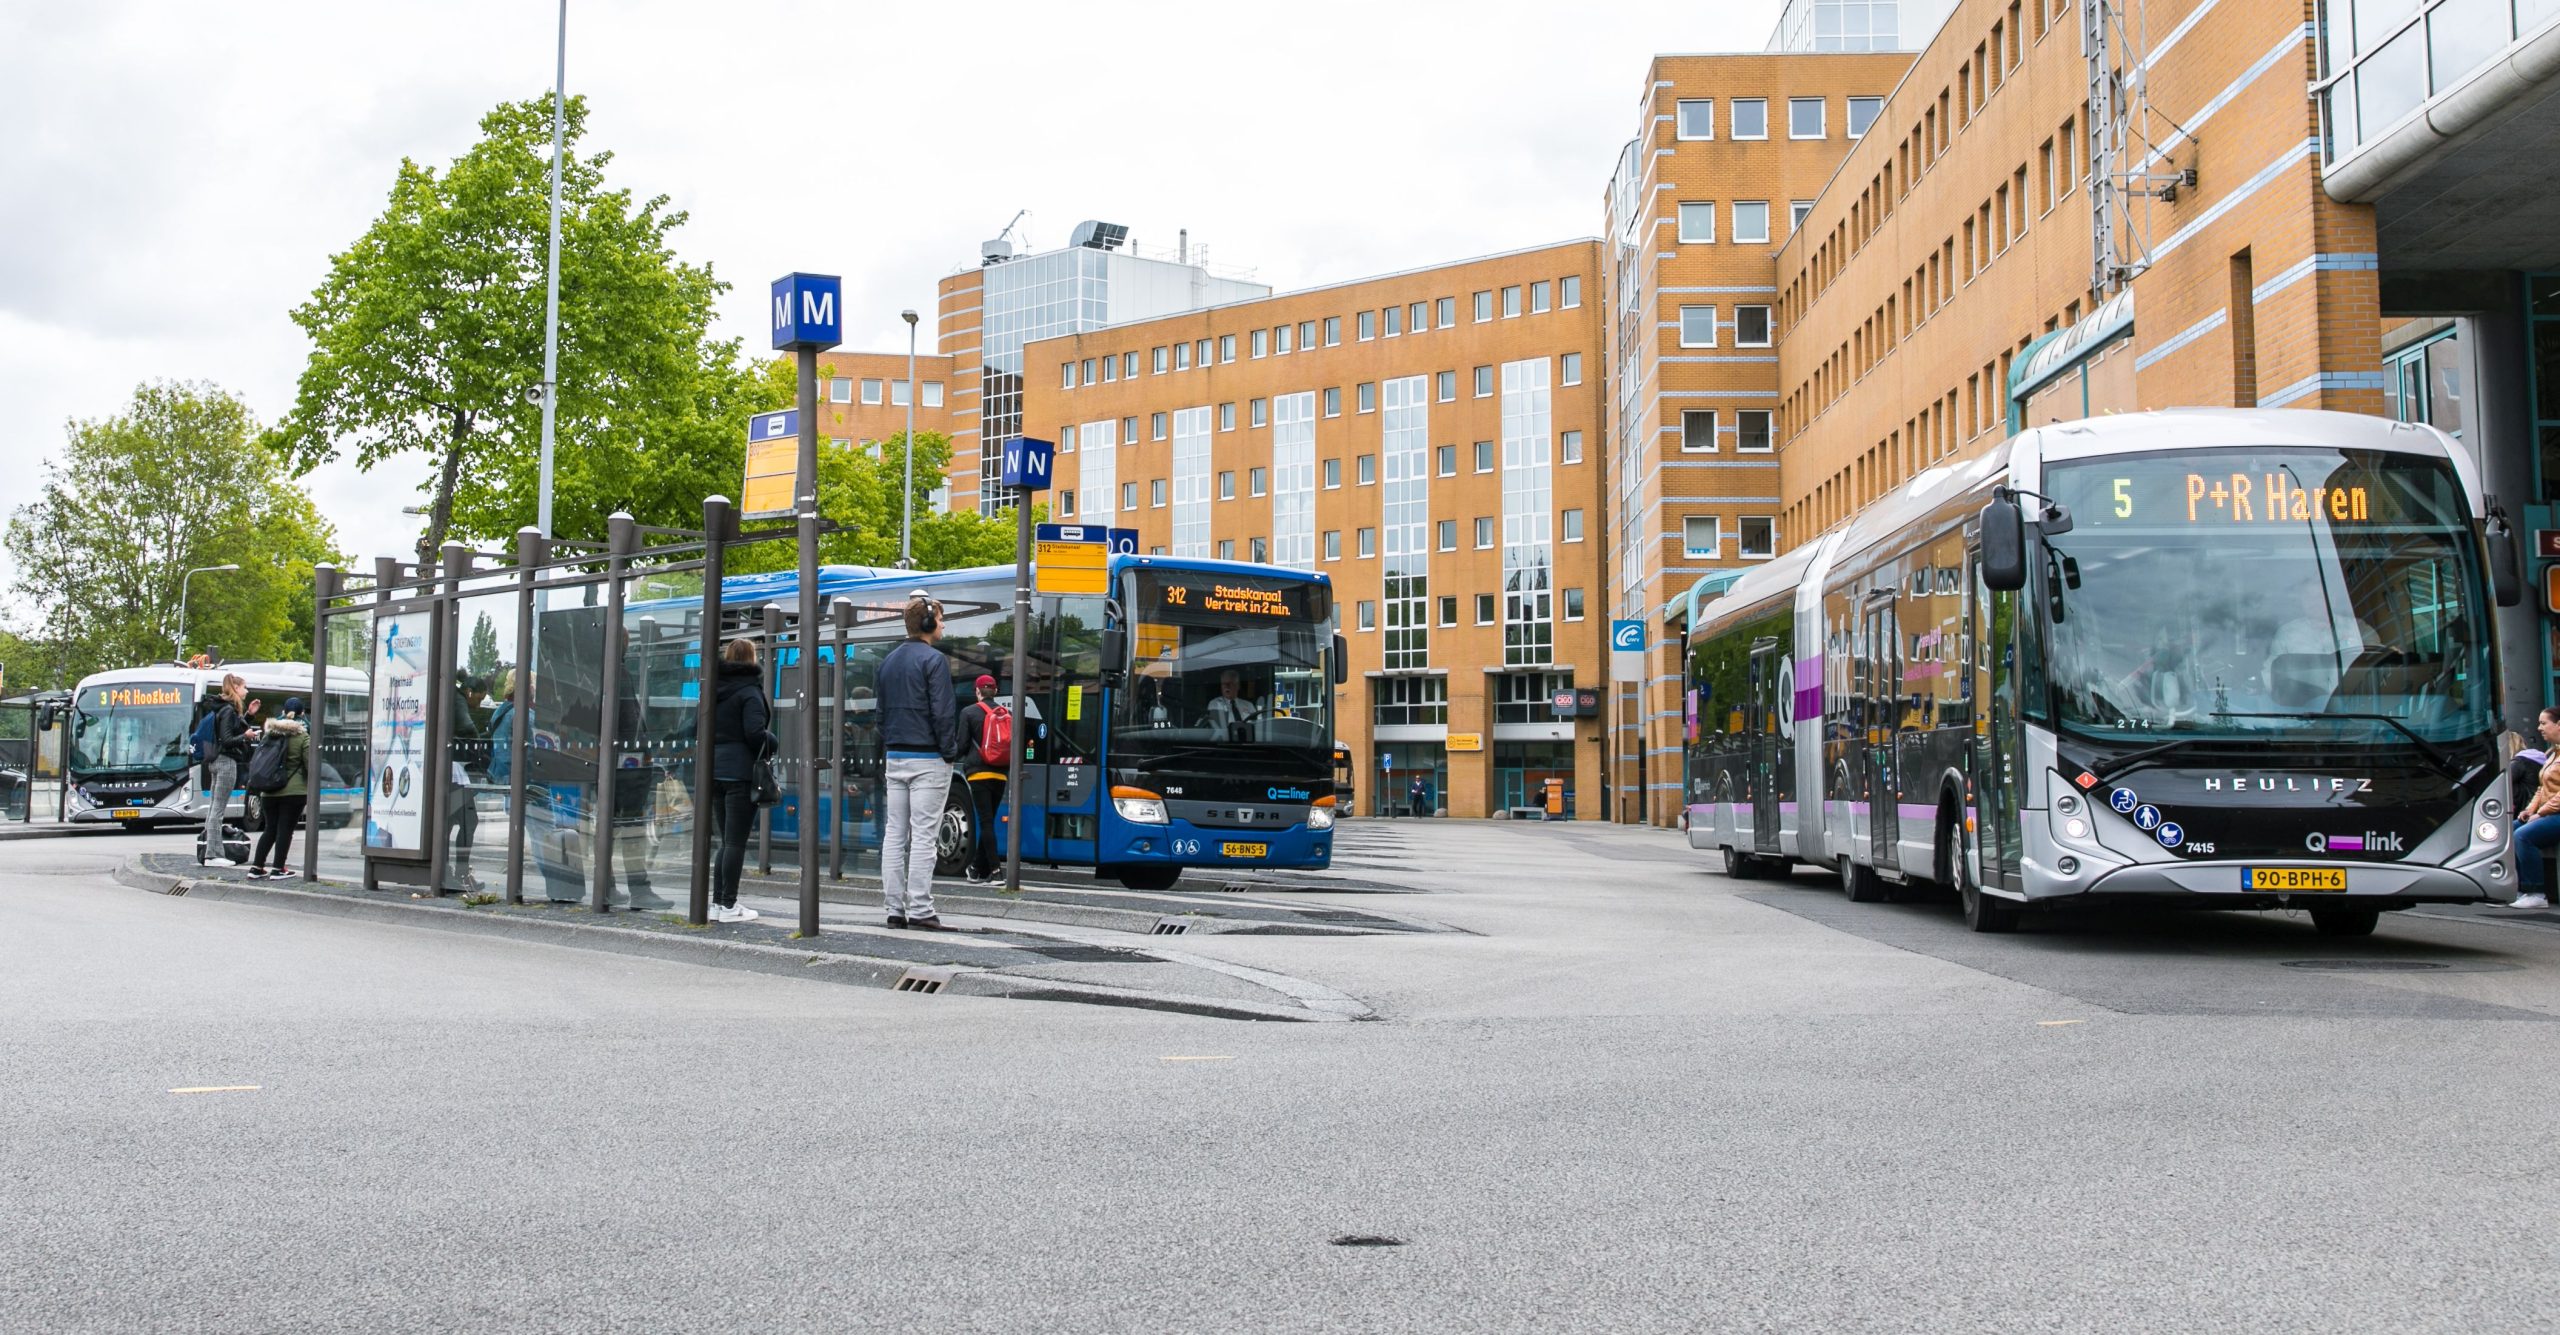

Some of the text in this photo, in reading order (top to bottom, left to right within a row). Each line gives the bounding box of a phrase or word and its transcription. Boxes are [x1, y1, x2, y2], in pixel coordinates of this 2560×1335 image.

[776, 292, 791, 330] M
[803, 290, 833, 326] M
[1007, 450, 1019, 474] N
[1028, 451, 1046, 476] N
[2113, 473, 2368, 521] 5 P+R Haren
[1038, 543, 1051, 553] 312
[1120, 538, 1134, 554] O
[1167, 586, 1187, 605] 312
[1215, 585, 1282, 603] Stadskanaal
[1205, 597, 1291, 616] Vertrek in 2 min.
[101, 687, 181, 706] 3 P+R Hoogkerk
[1166, 787, 1183, 795] 7648
[2205, 778, 2373, 792] HEULIEZ
[1207, 809, 1280, 820] SETRA
[1226, 844, 1265, 855] 56-BNS-5
[2186, 843, 2215, 853] 7415
[2257, 871, 2341, 887] 90-BPH-6
